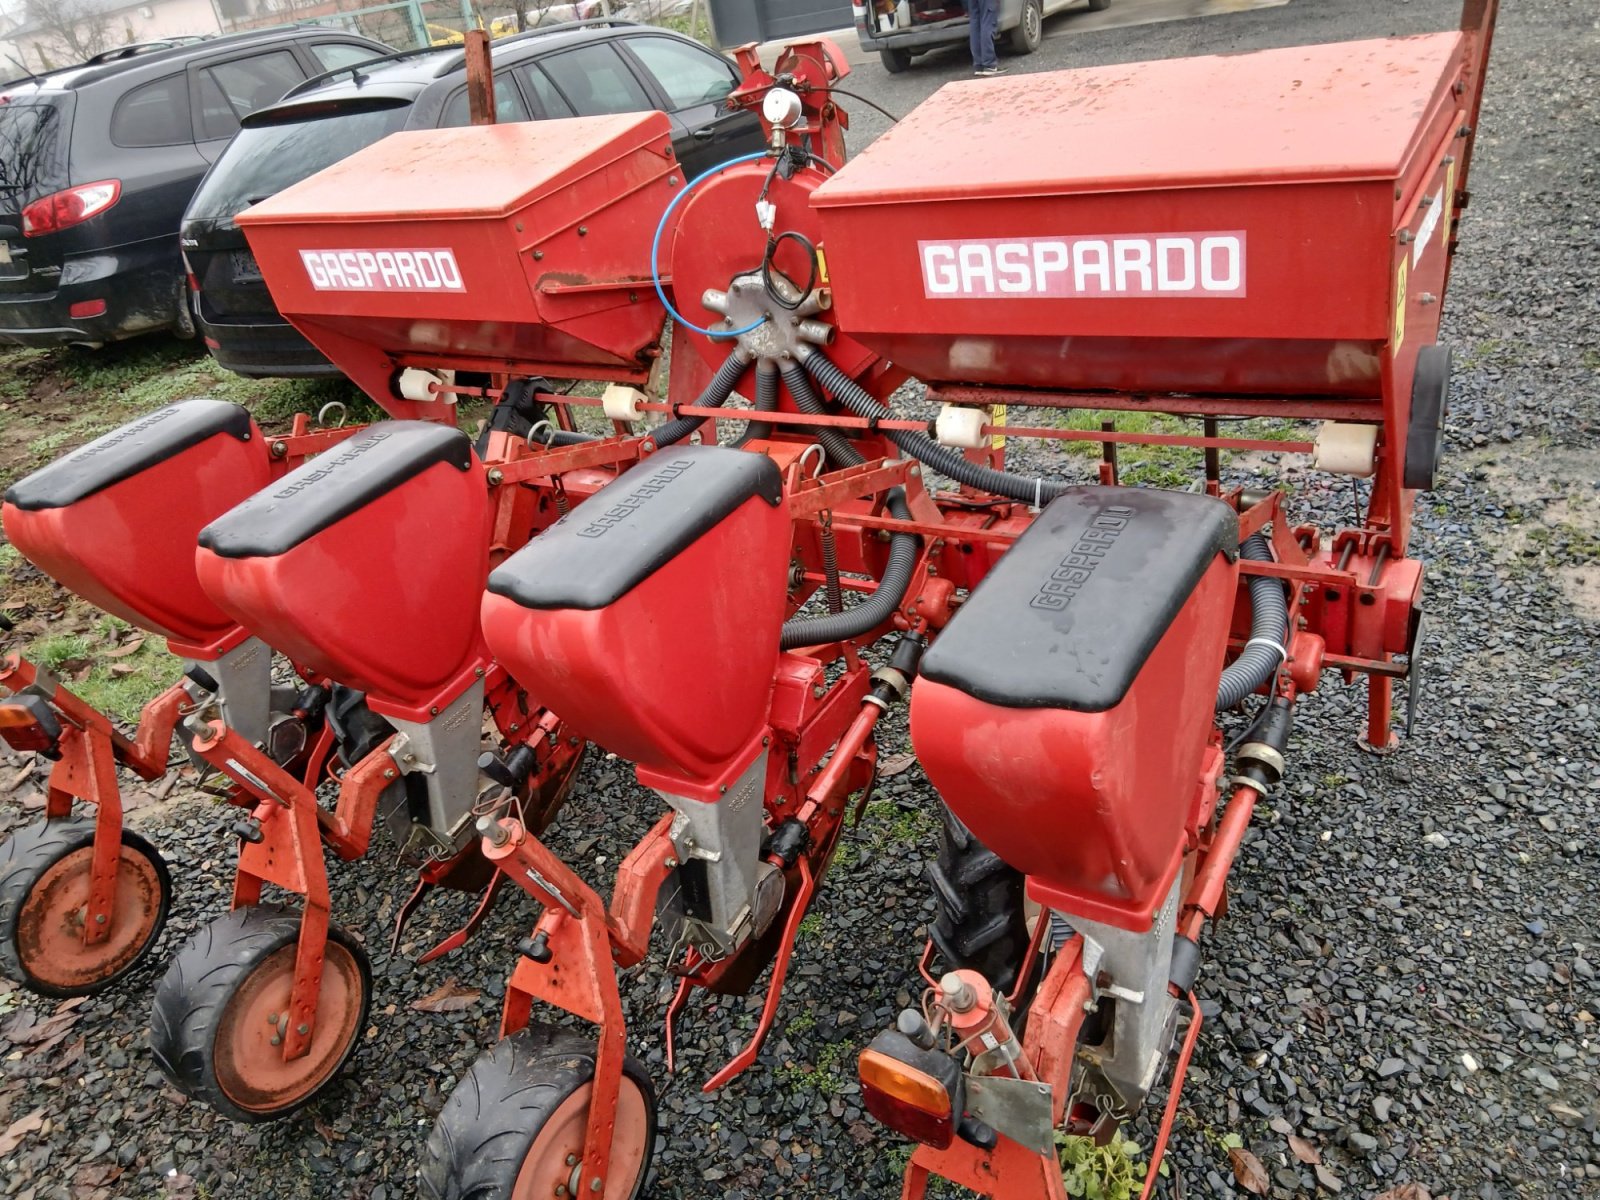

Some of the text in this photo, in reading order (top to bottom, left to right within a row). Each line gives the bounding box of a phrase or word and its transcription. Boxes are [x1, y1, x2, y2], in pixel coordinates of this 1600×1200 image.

[303, 251, 462, 289] GASPARDO
[924, 237, 1240, 293] GASPARDO
[576, 460, 696, 538] GASPARDO
[1029, 506, 1136, 611] GASPARDO
